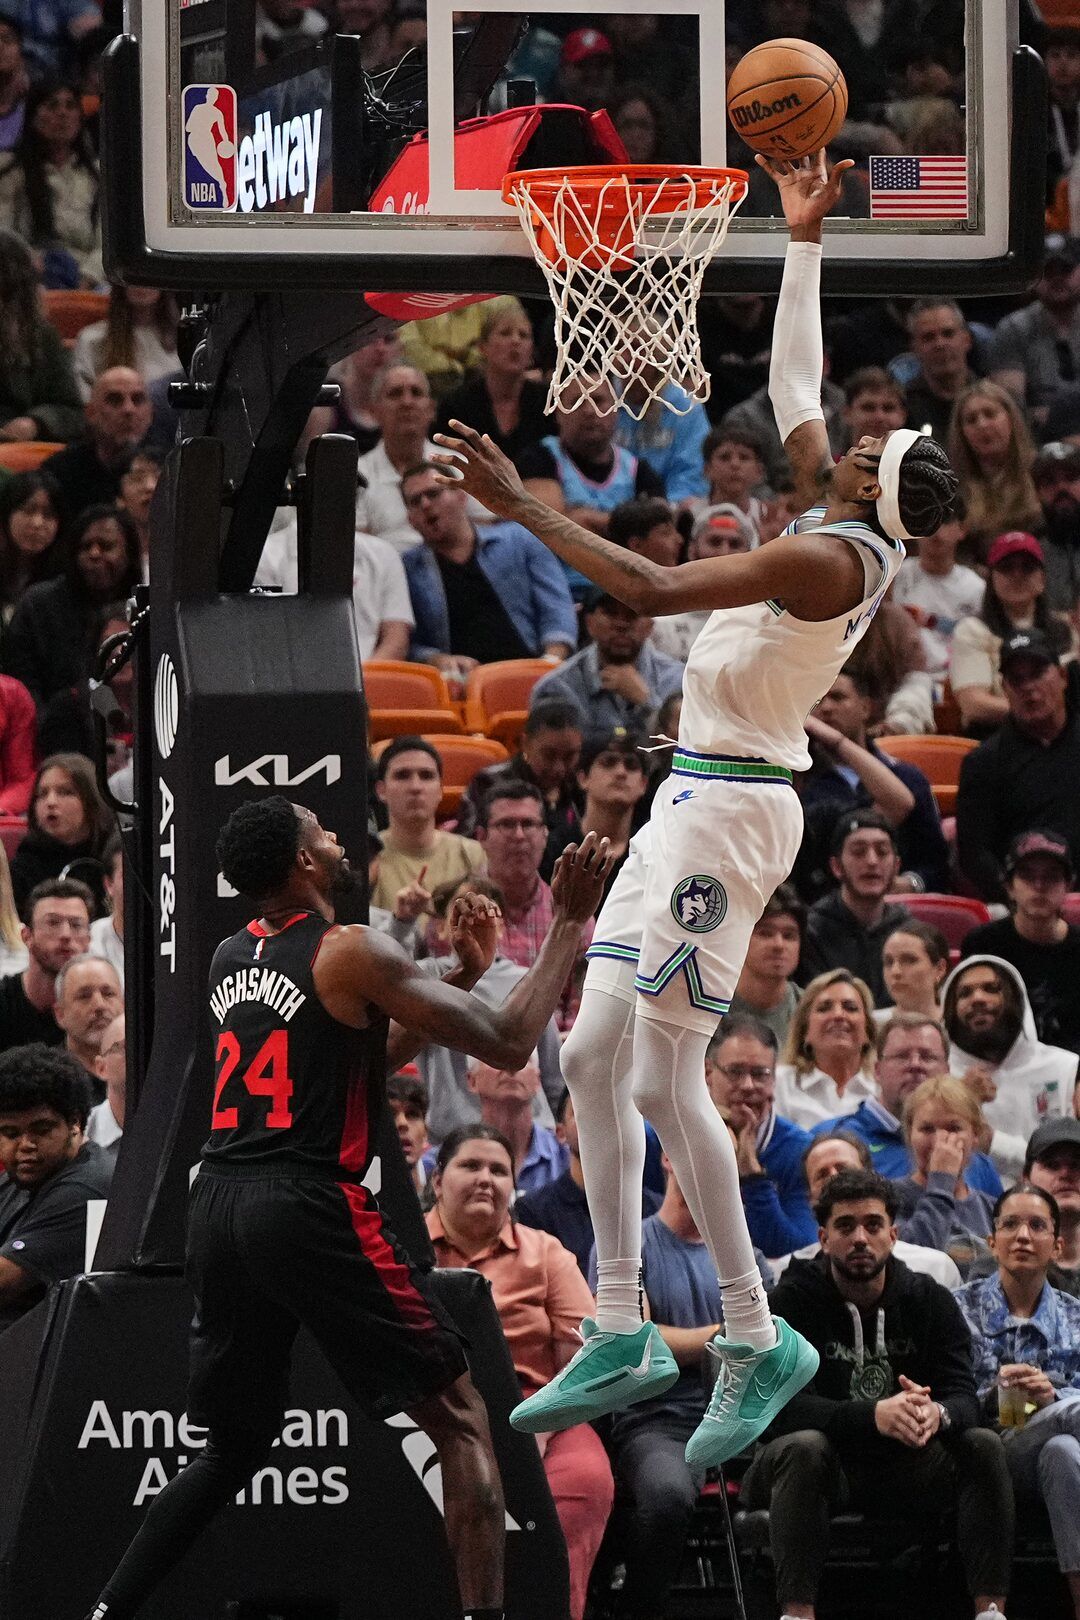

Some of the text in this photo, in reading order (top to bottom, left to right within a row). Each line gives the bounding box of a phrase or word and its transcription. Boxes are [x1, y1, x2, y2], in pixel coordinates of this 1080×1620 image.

[731, 93, 802, 128] Wilson
[229, 108, 323, 213] etway
[191, 183, 217, 203] NBA
[214, 754, 341, 786] KIA
[159, 776, 176, 974] AT&T
[209, 967, 307, 1025] HIGHSMITH
[211, 1029, 293, 1130] 24
[77, 1400, 349, 1449] Amean
